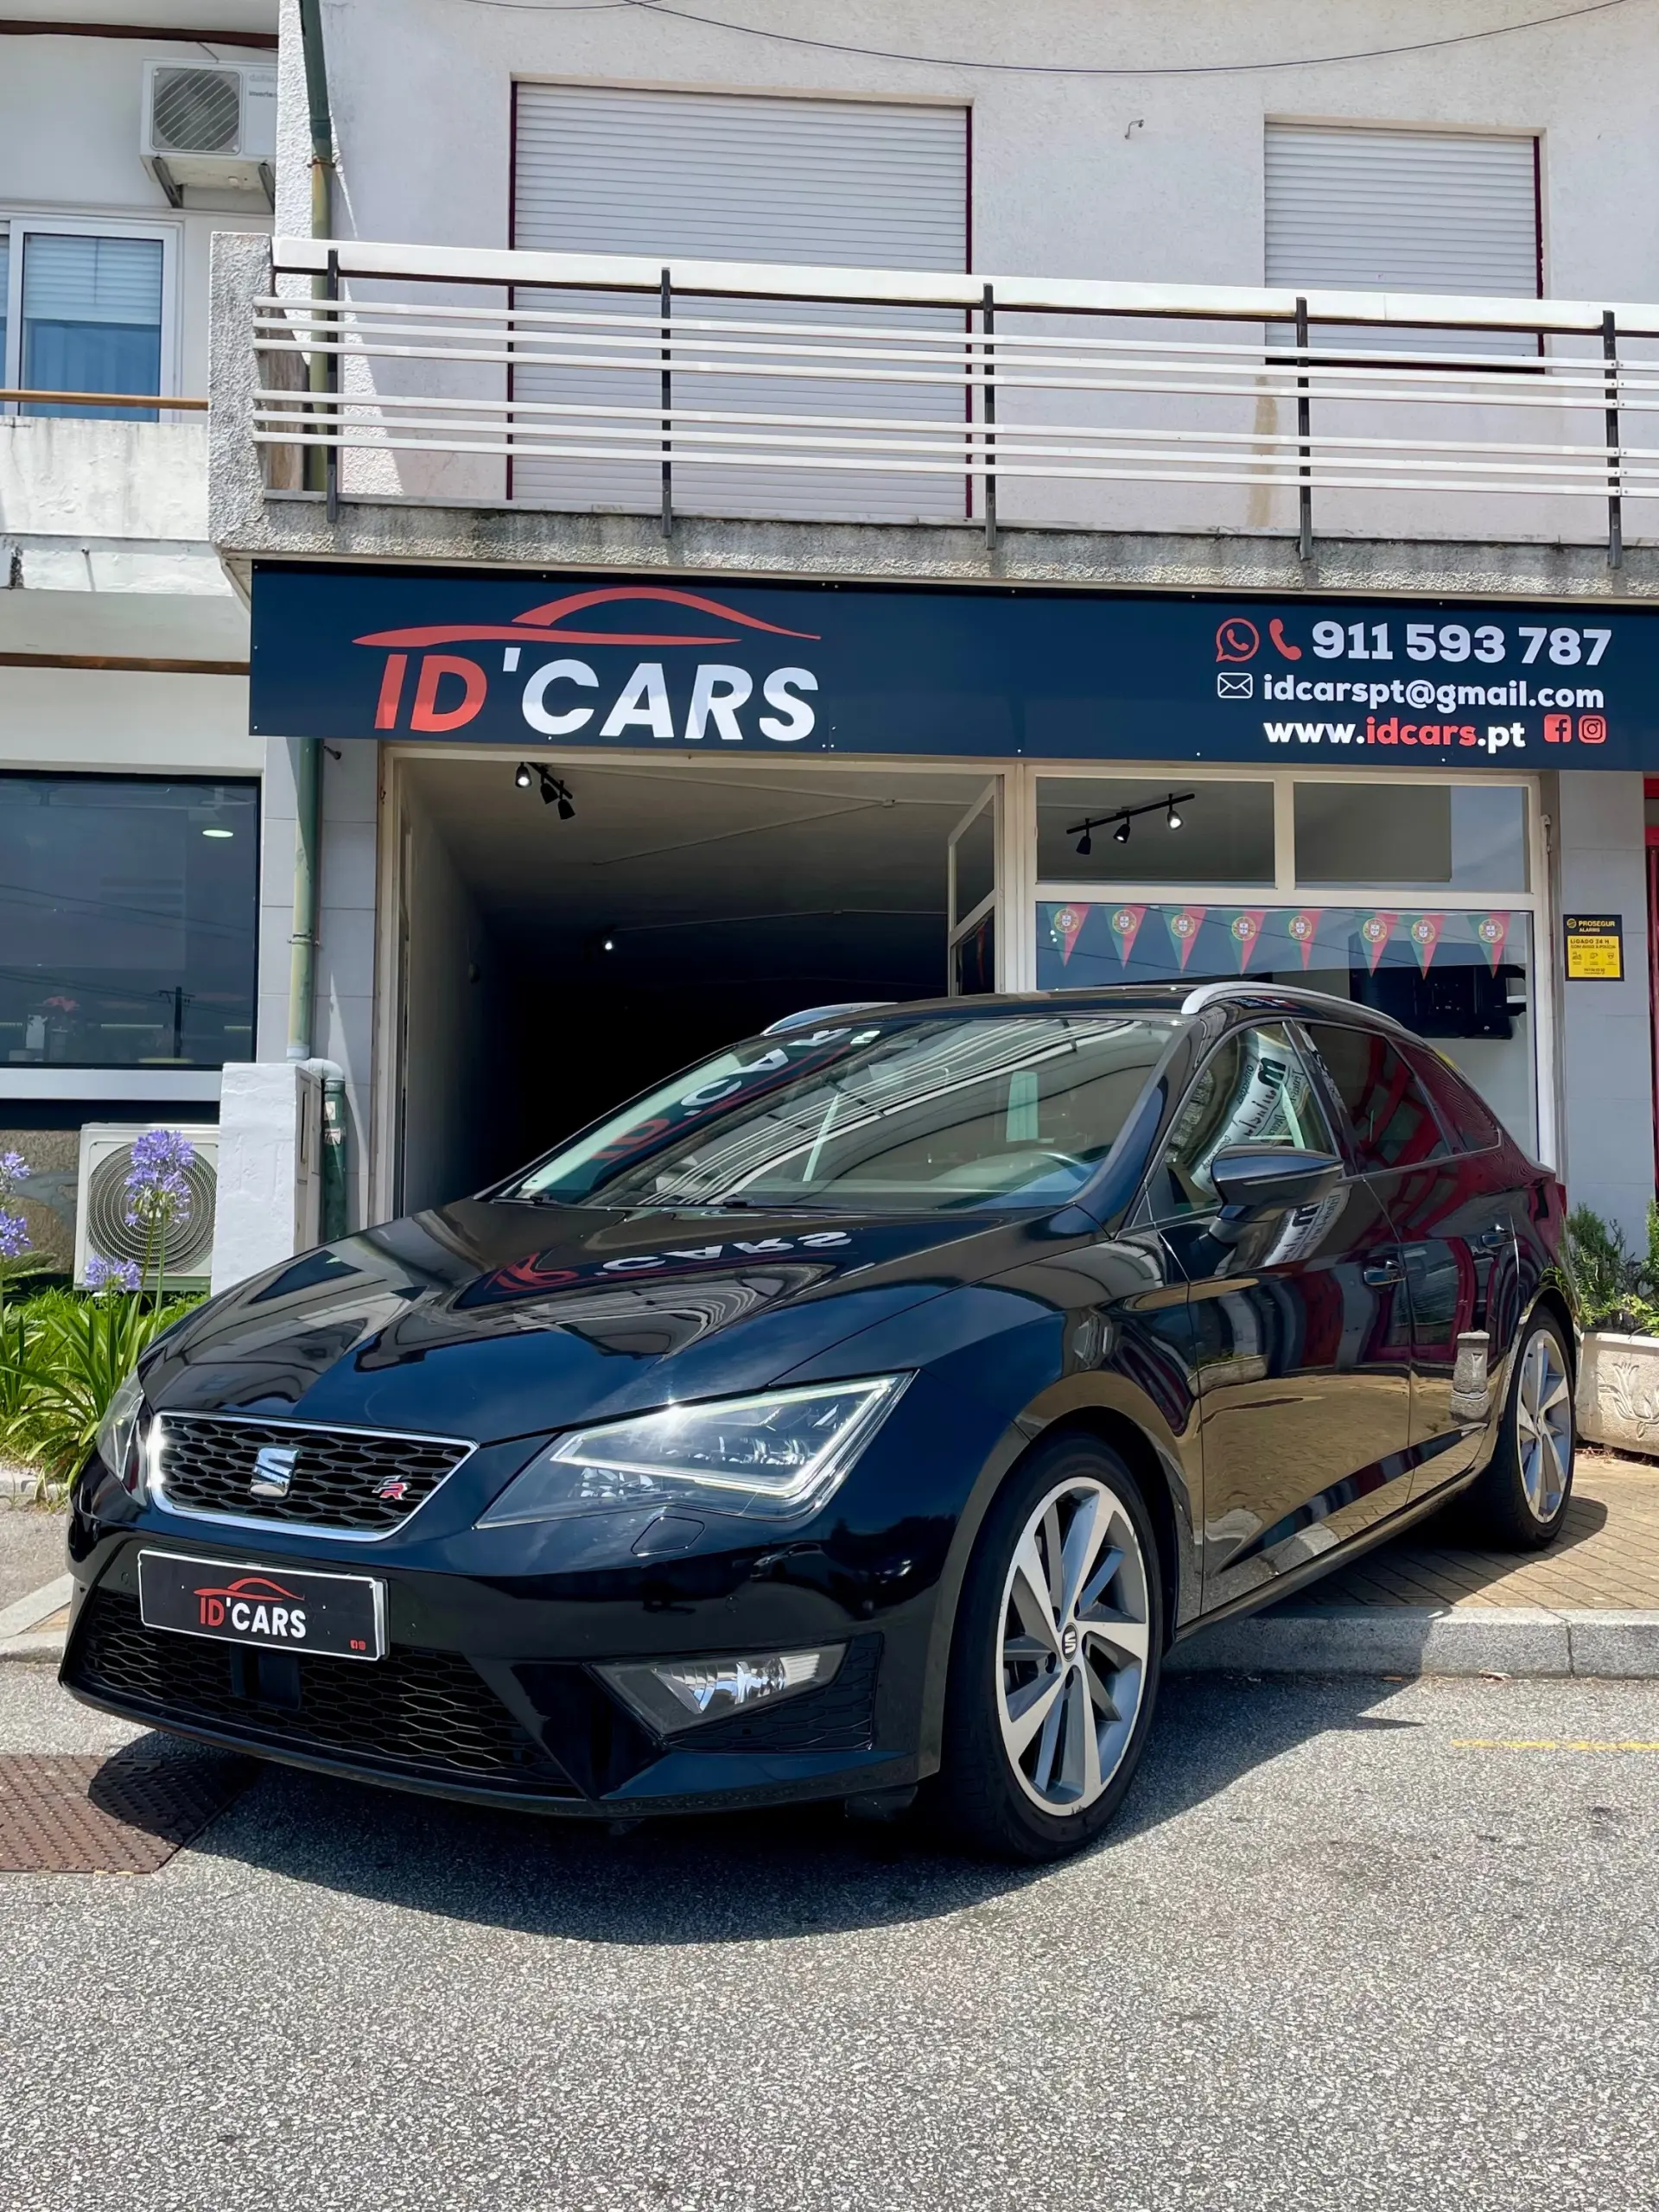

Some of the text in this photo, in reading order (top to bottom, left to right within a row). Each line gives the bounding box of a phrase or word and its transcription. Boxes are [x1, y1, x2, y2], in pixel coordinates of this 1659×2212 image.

[1312, 620, 1612, 666] 911 593 787
[374, 647, 819, 741] ID'CARS
[1263, 674, 1605, 714] idcarspt@gmail.com
[1263, 716, 1527, 753] www.idcars.pt
[199, 1595, 307, 1638] ID'CARS
